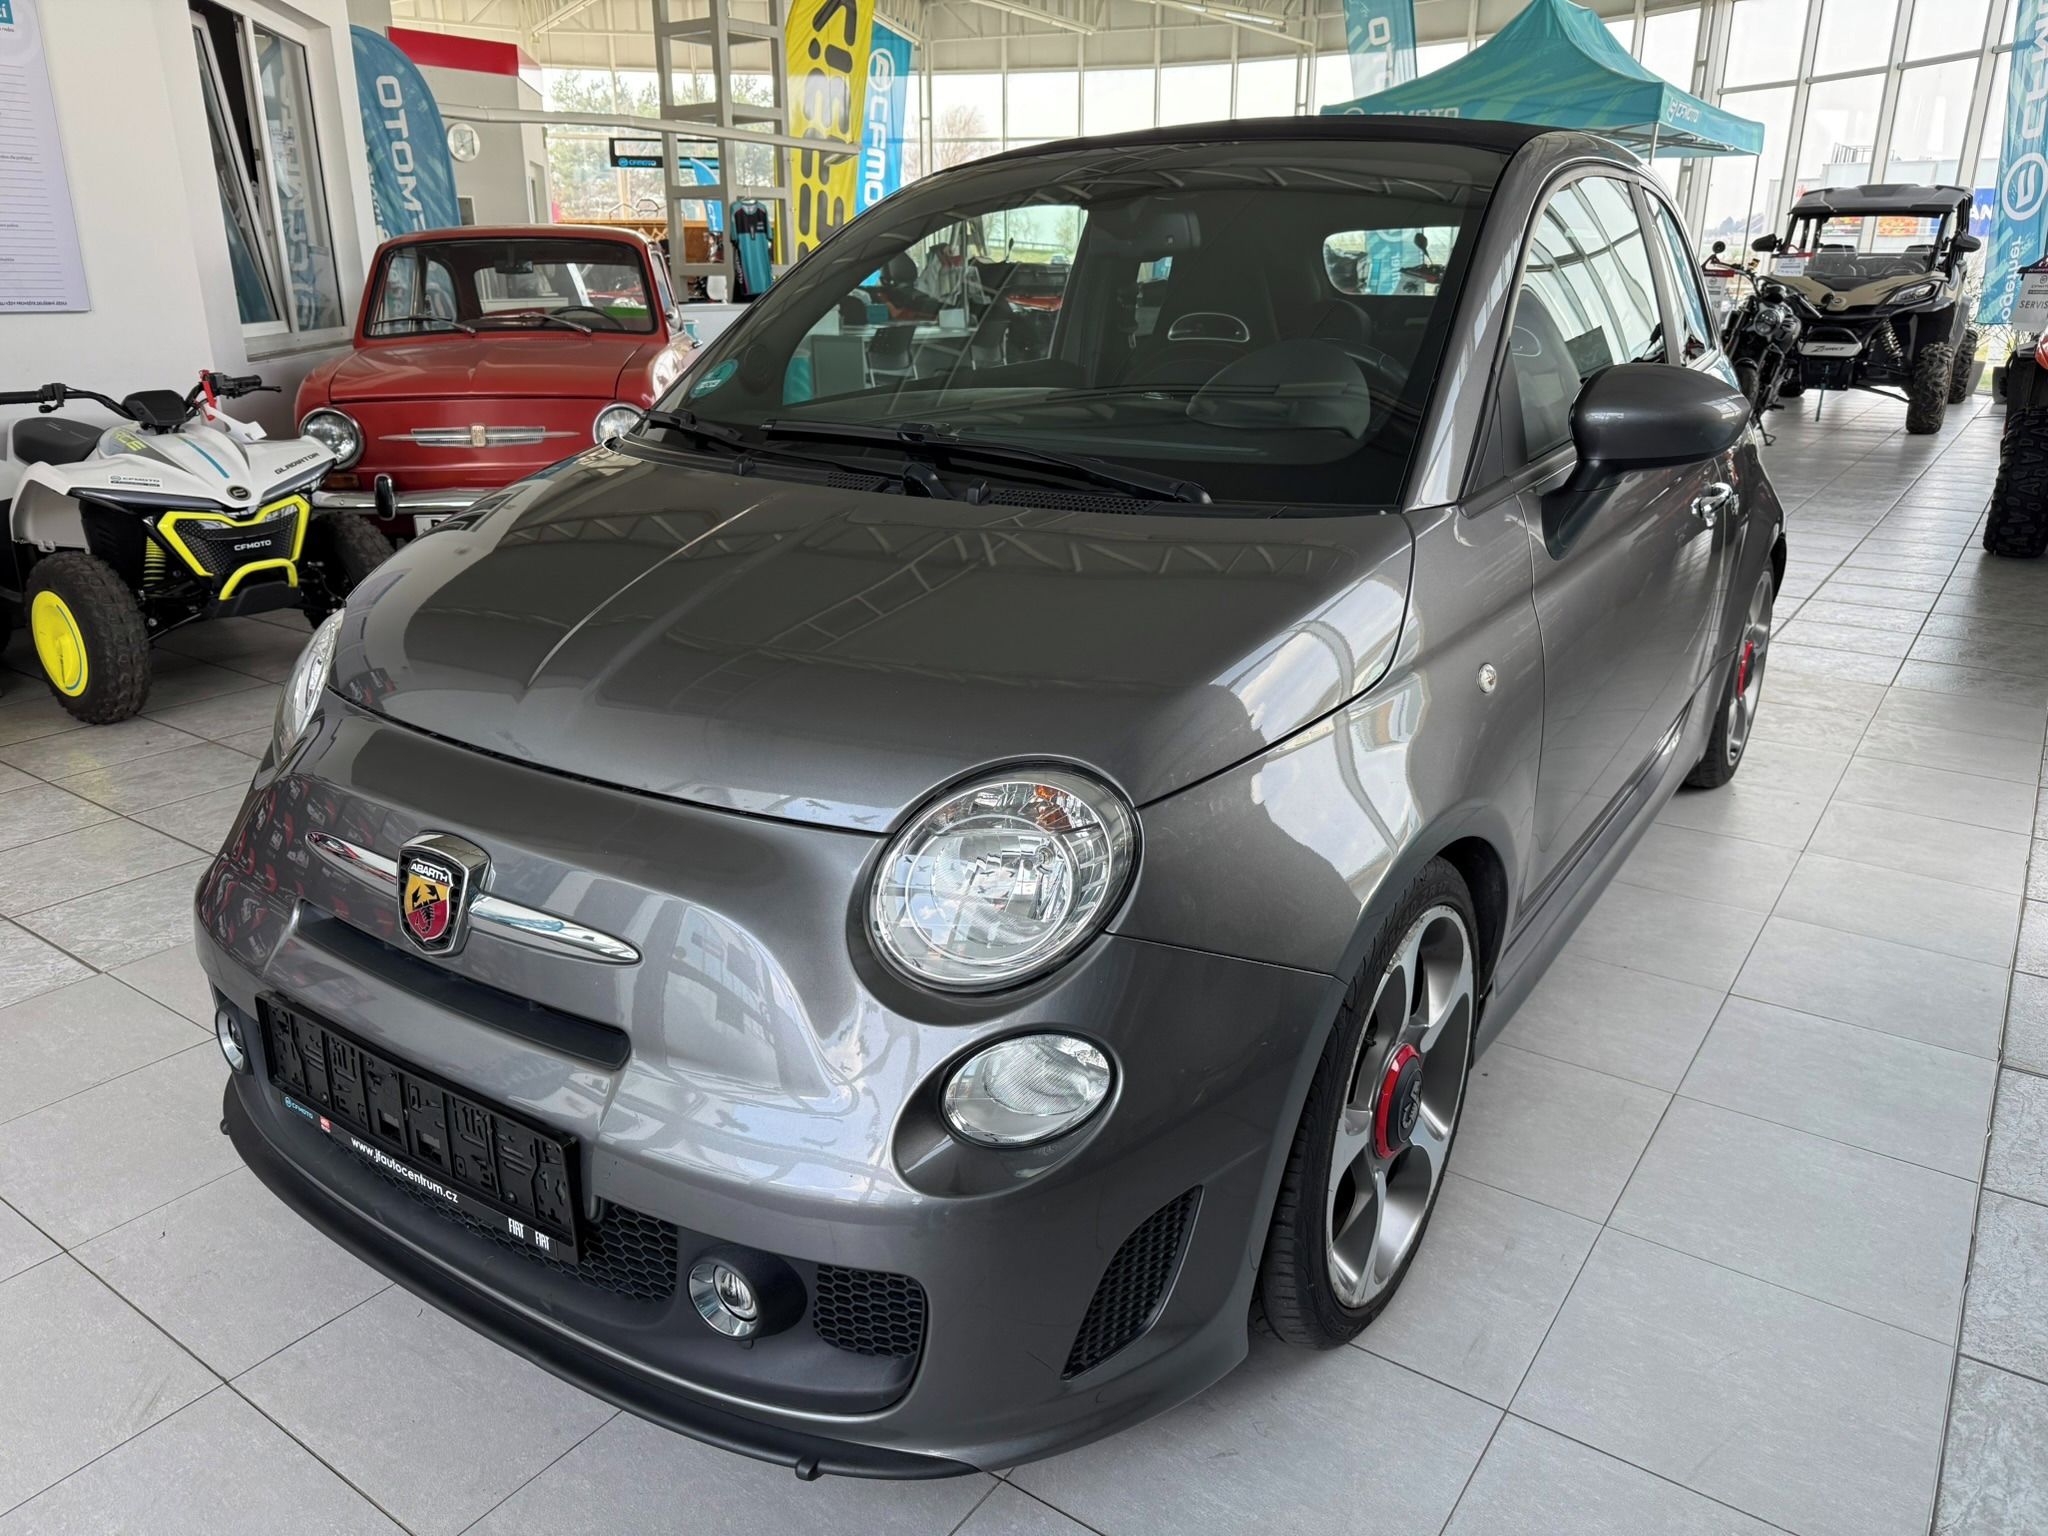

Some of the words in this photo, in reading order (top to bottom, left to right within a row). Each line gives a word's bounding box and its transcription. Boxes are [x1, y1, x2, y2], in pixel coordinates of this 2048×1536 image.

[863, 99, 890, 207] CFMO
[274, 452, 320, 475] GLADIATOR
[234, 539, 272, 552] CFMOTO
[410, 862, 448, 883] ABARTH
[350, 1136, 459, 1204] www.jfautocentrum.cz
[508, 1216, 524, 1239] FIAT
[534, 1230, 550, 1252] FIAT
